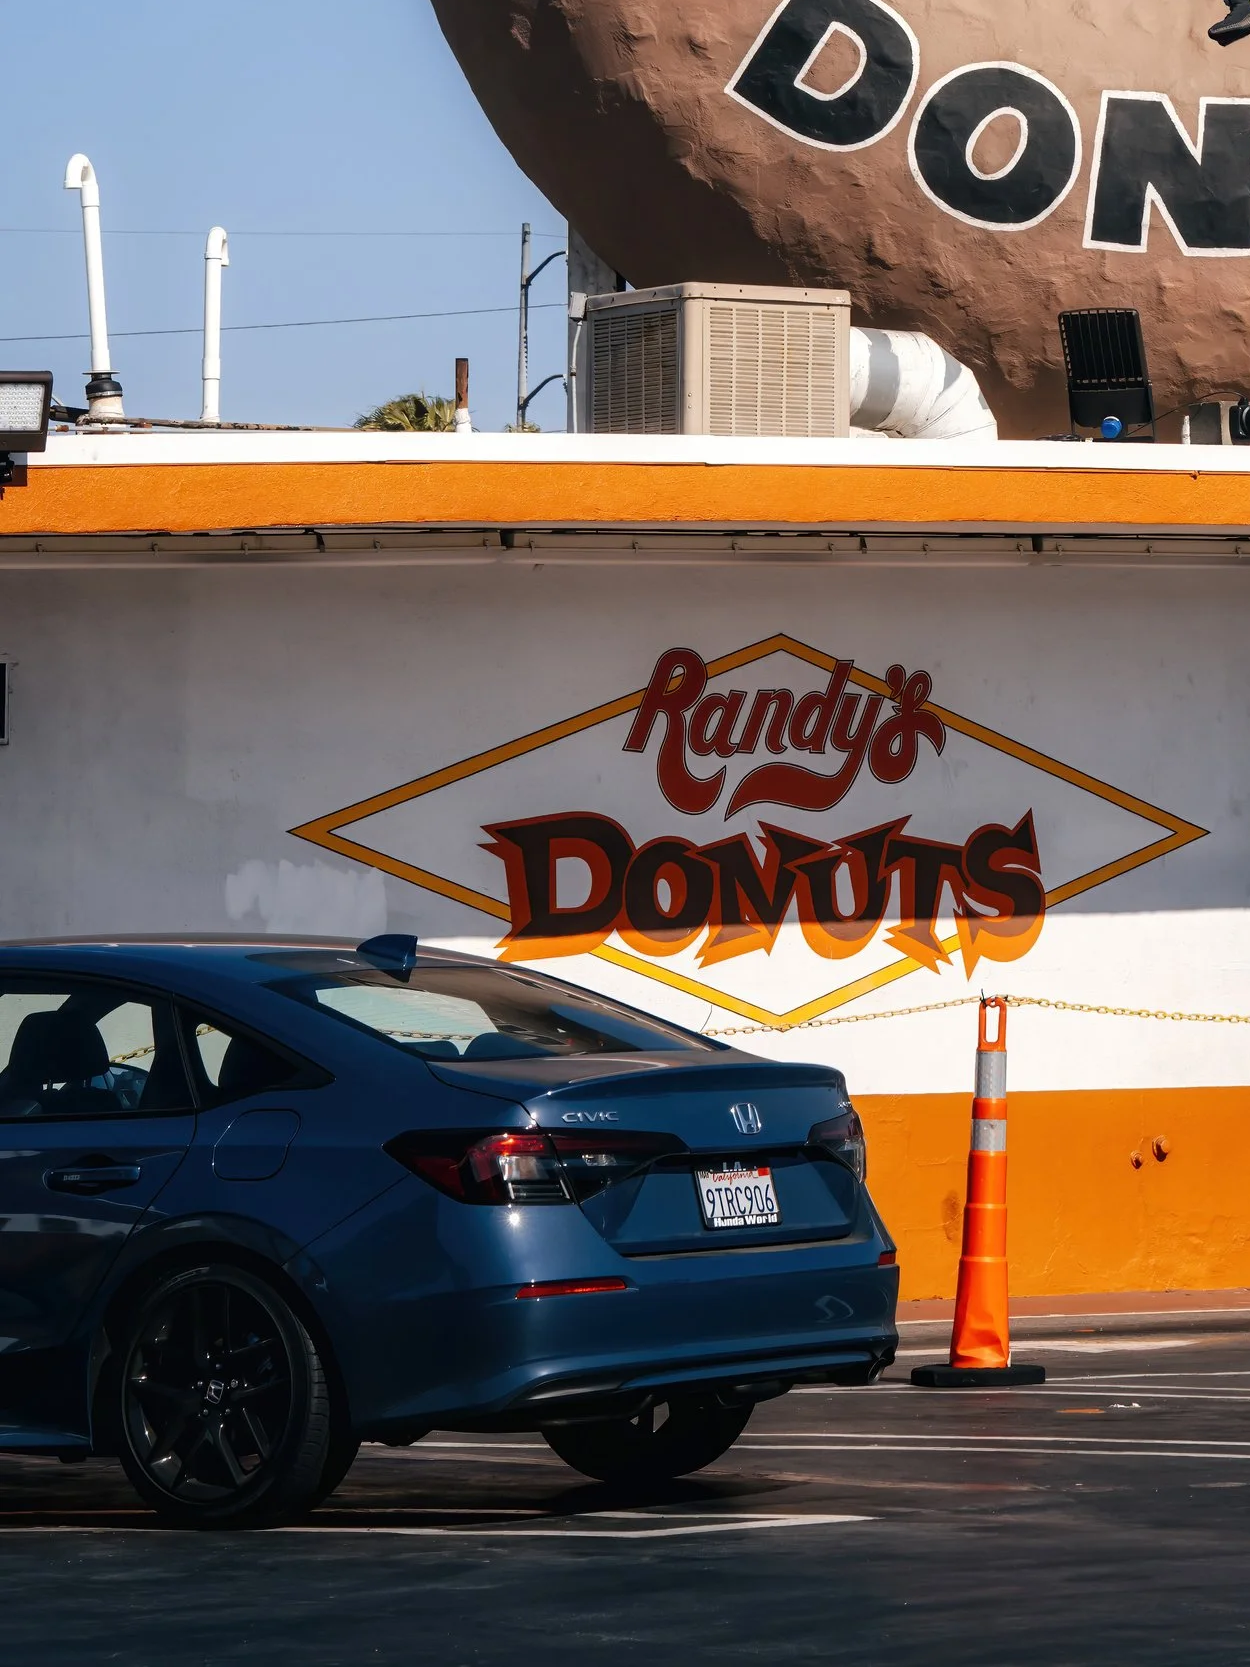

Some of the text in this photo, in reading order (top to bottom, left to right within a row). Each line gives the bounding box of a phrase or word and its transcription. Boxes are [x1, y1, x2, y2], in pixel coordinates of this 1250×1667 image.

[622, 647, 946, 820] Randy's
[477, 807, 1046, 981] DONUTS
[562, 1111, 619, 1122] CIVIC
[723, 1161, 747, 1172] L.A.
[706, 1184, 774, 1217] 9TRC906
[745, 1214, 778, 1225] World
